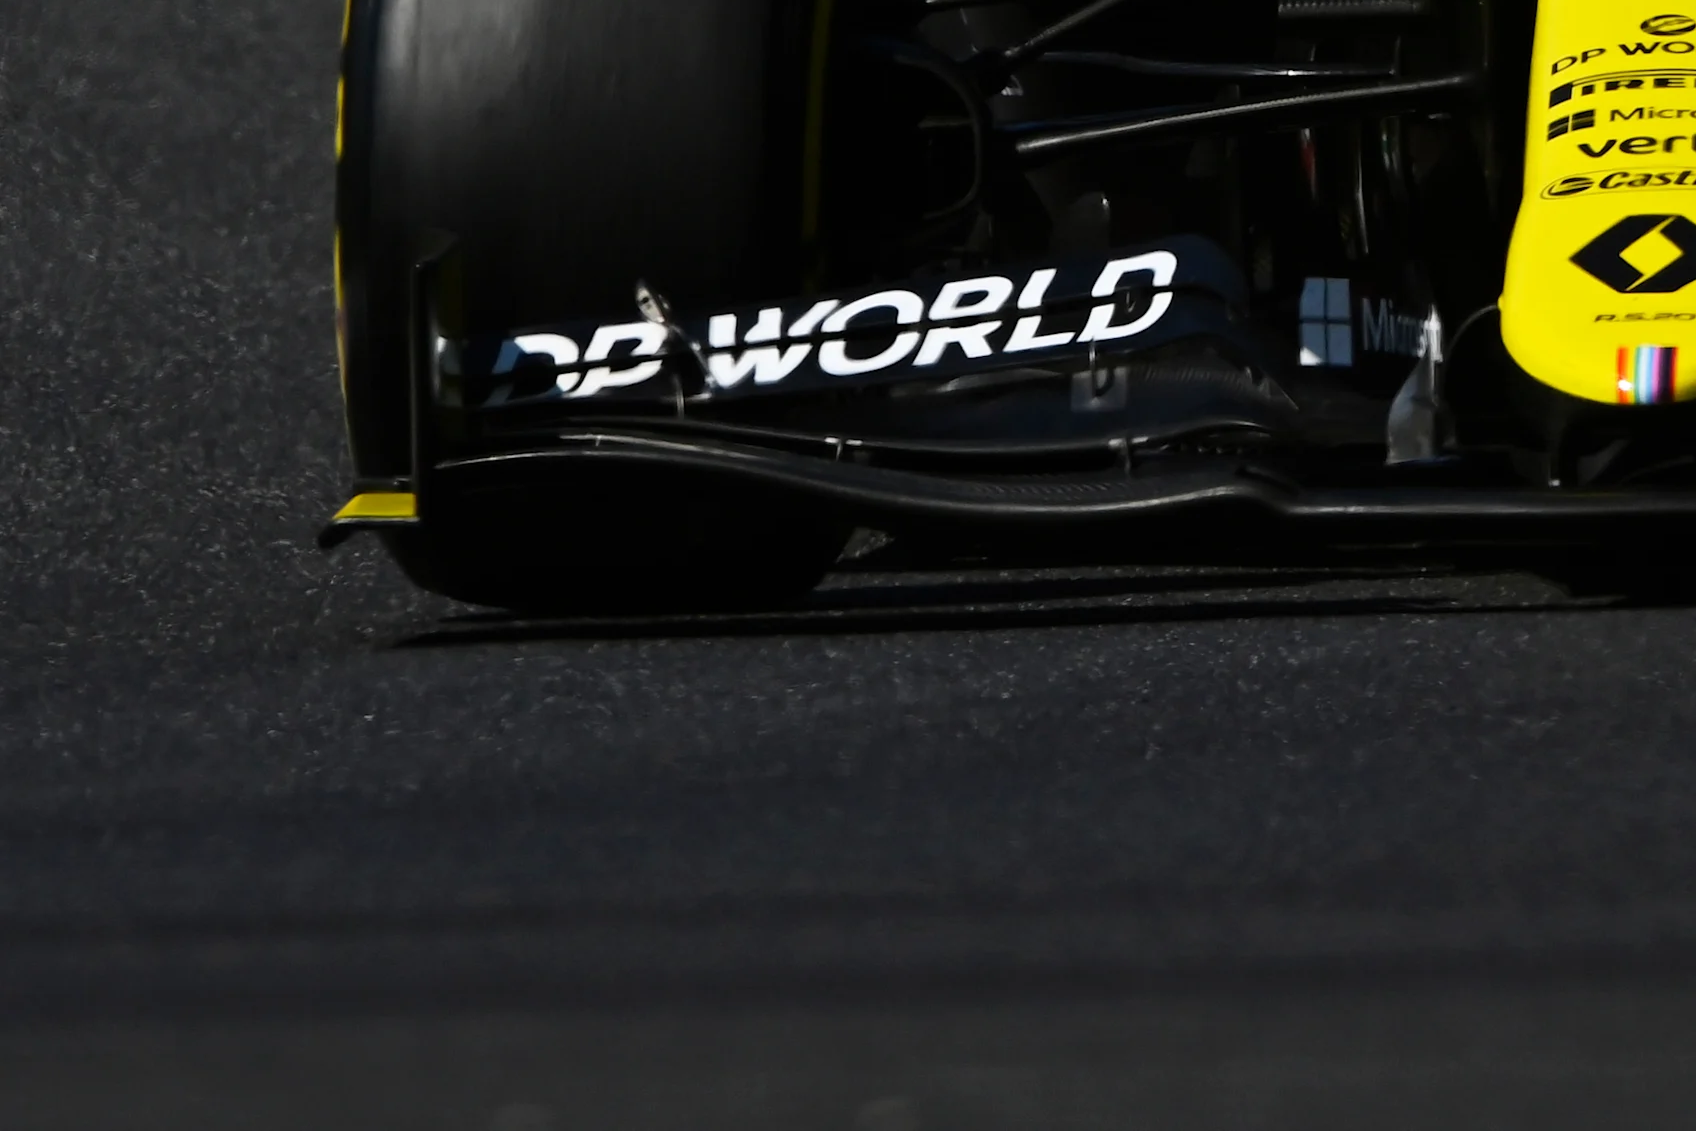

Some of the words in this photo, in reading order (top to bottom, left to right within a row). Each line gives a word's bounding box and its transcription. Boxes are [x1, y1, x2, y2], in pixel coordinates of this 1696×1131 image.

[1551, 48, 1607, 75] DP
[481, 322, 669, 408] DP
[708, 249, 1179, 388] WORLD
